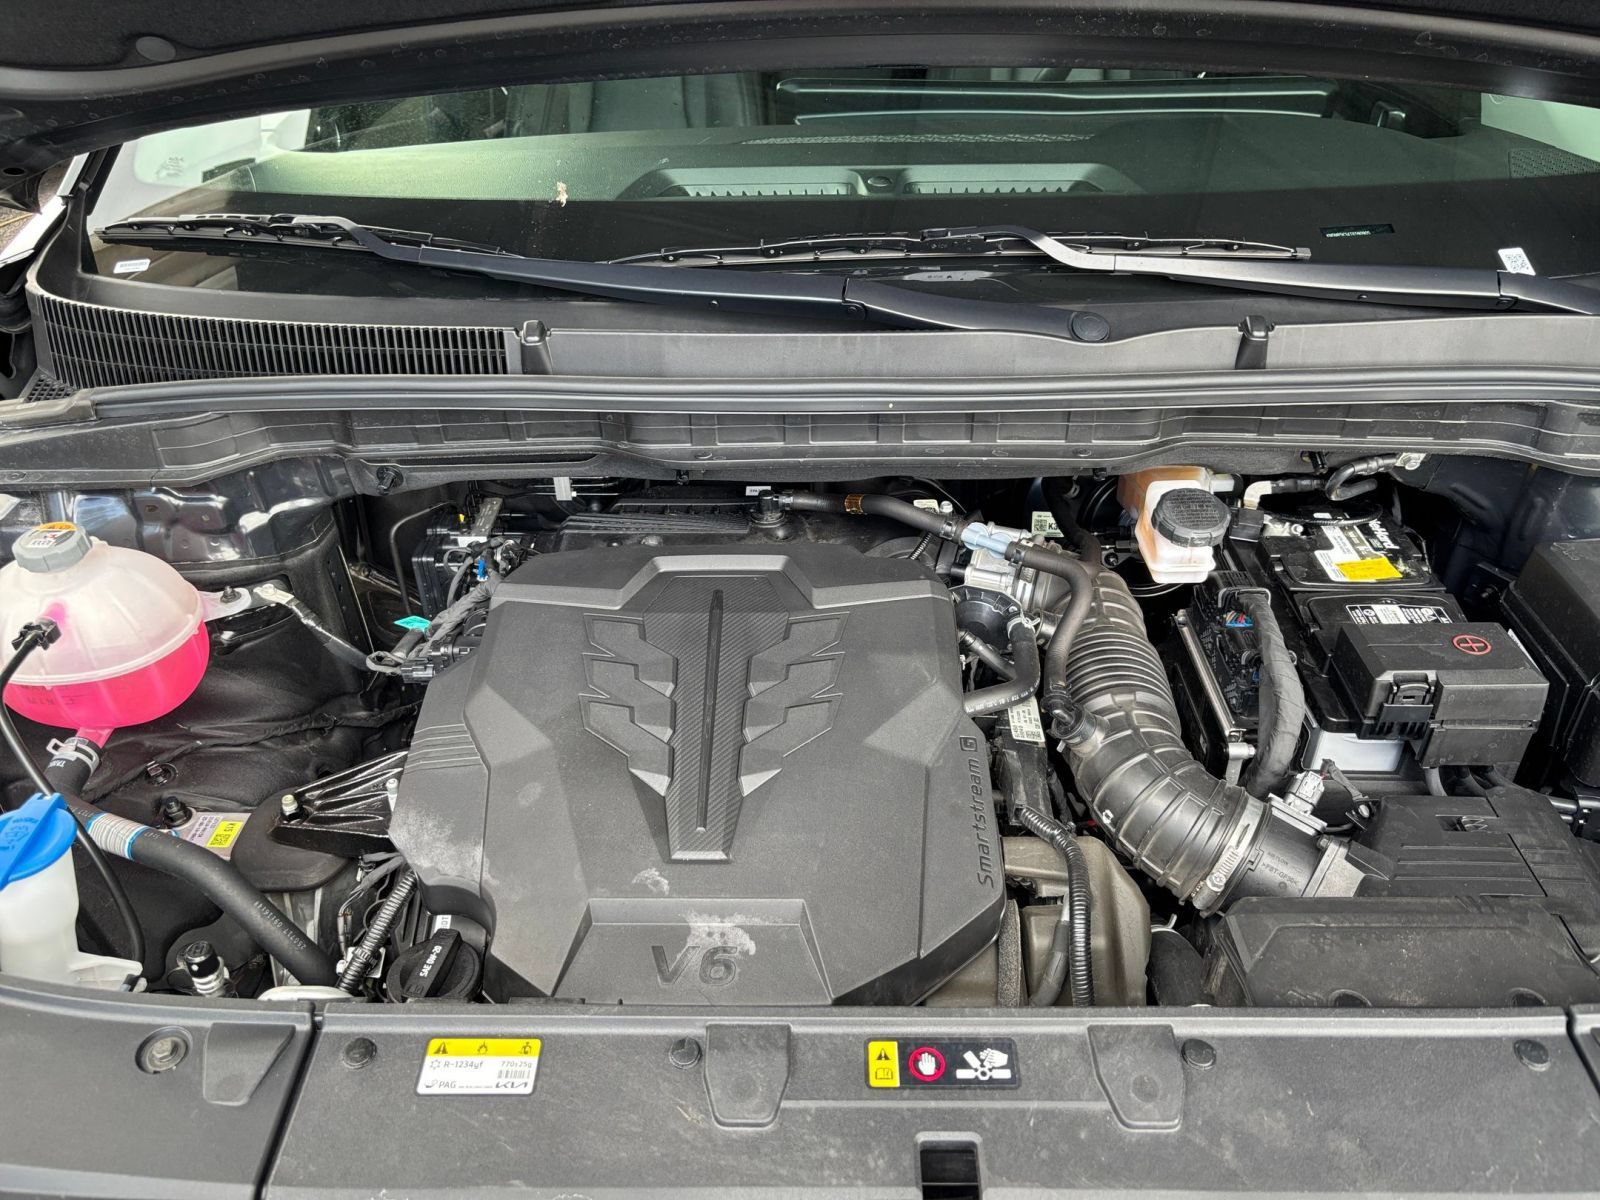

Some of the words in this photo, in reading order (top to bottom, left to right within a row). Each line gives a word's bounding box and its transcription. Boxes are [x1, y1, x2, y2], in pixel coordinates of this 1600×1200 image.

[968, 758, 994, 888] Smartstream
[419, 963, 432, 978] SAE
[651, 945, 738, 986] V6
[443, 1060, 483, 1069] R-1234yf
[438, 1080, 456, 1089] PAG
